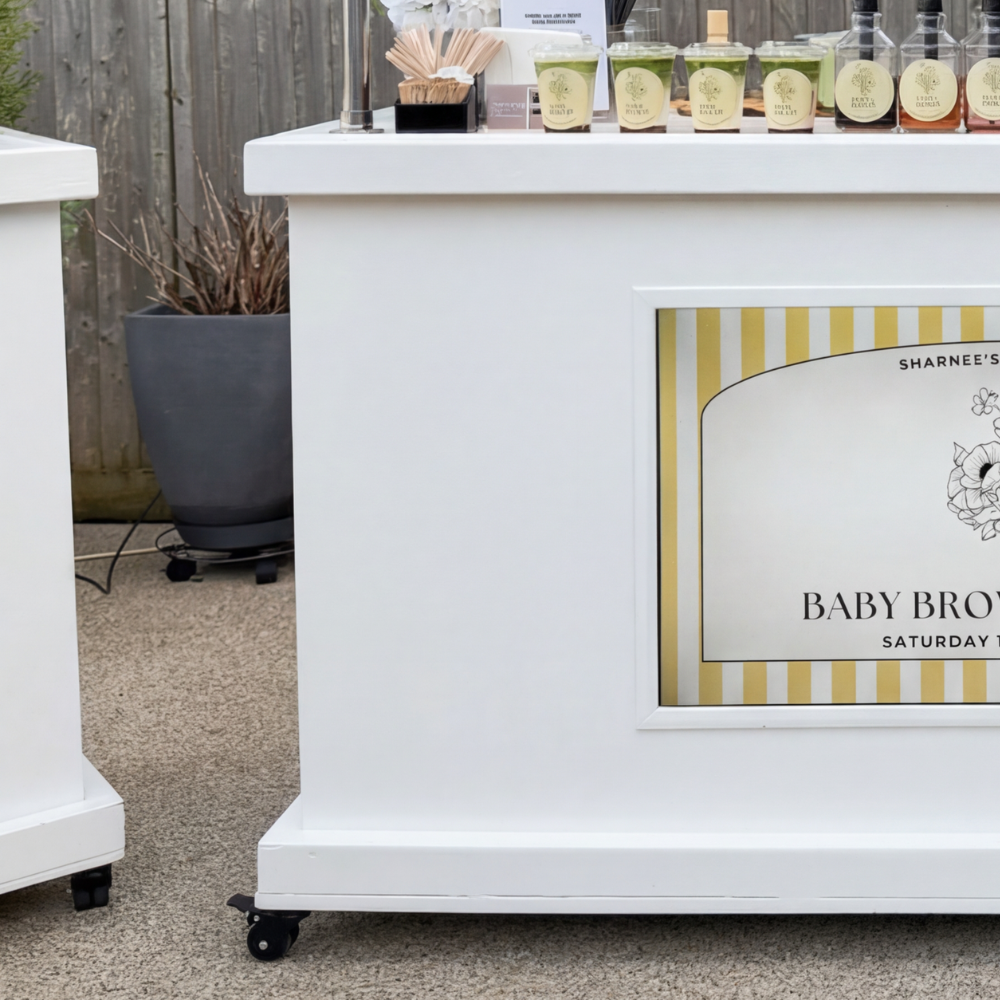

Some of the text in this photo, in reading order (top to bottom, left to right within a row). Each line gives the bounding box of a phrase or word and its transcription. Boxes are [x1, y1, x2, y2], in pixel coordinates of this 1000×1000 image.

[899, 353, 1000, 371] SHARNEE'S
[803, 591, 901, 620] BABY
[882, 634, 989, 649] SATURDAY
